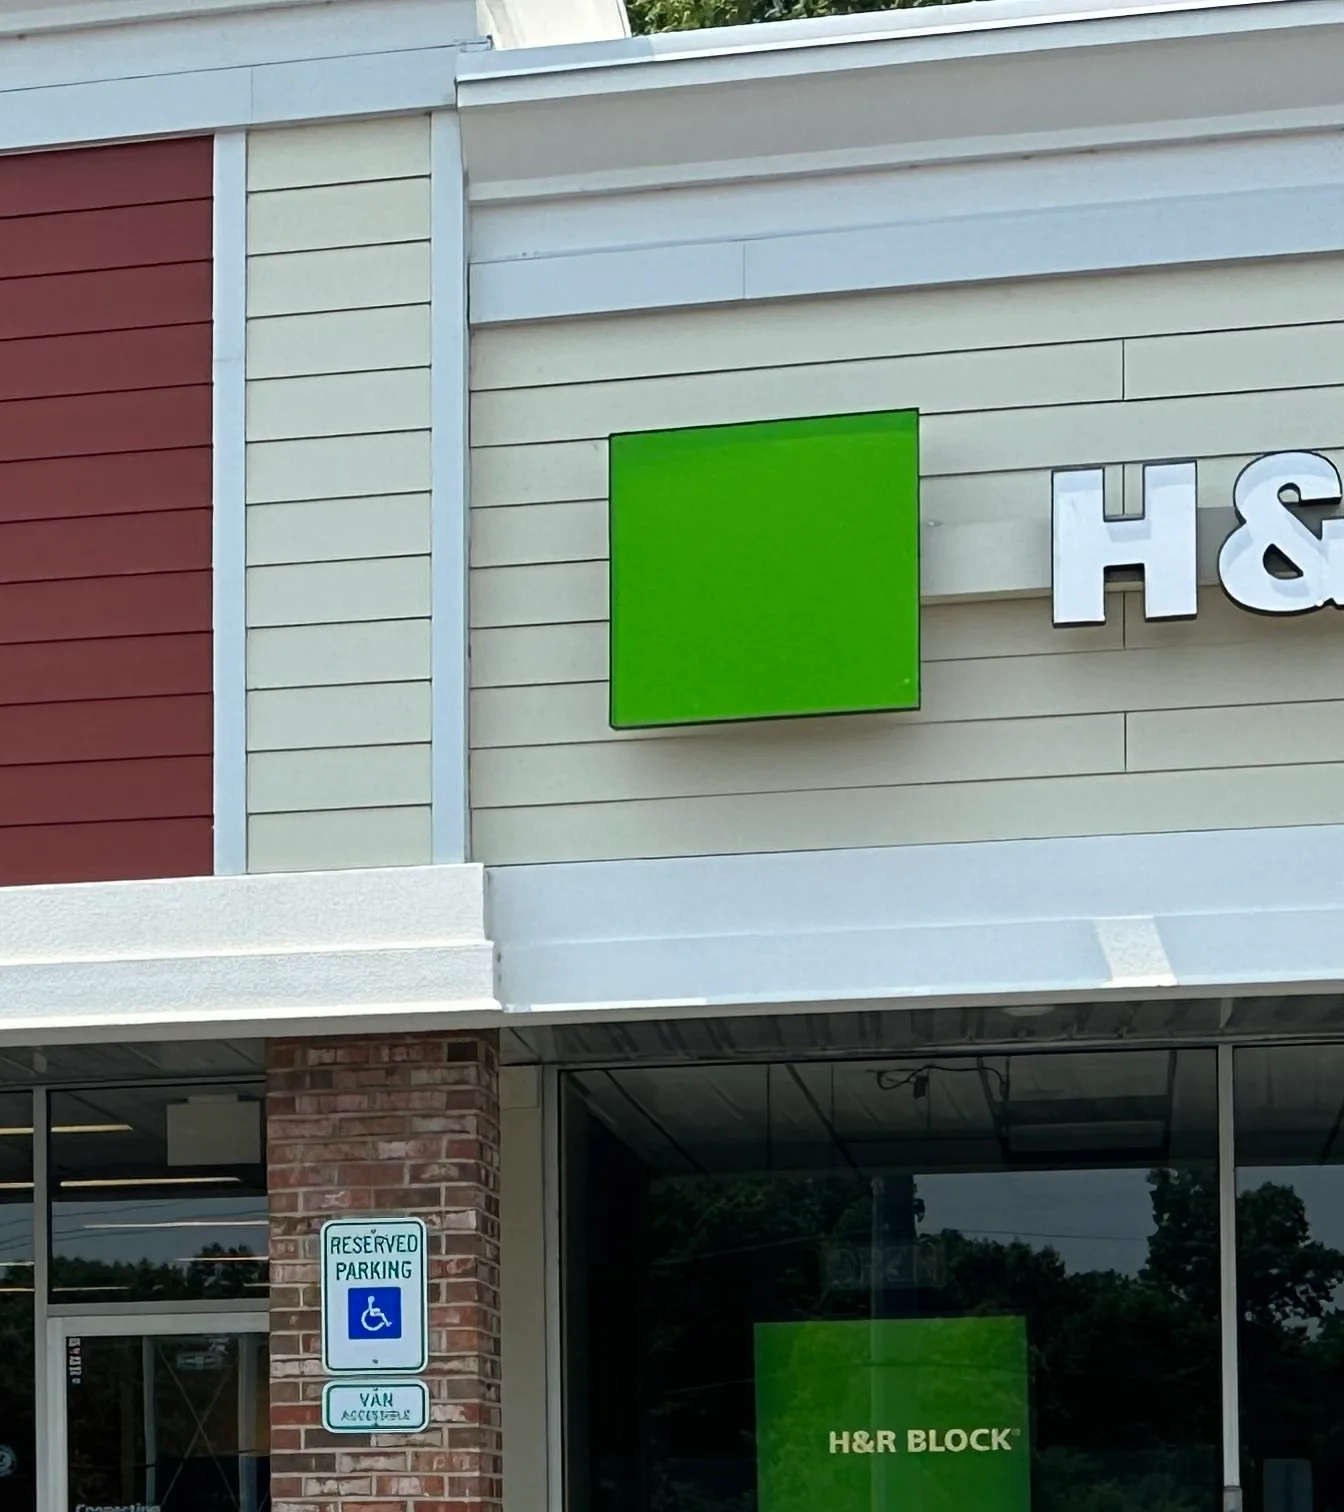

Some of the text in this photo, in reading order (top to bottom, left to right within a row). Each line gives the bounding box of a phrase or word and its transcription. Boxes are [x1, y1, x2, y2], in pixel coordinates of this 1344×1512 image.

[329, 1233, 419, 1255] RESERVED
[335, 1260, 413, 1281] PARKING
[359, 1391, 394, 1407] VAN
[340, 1409, 411, 1421] ACCESSIBLE
[828, 1427, 1013, 1454] H&R BLOCK
